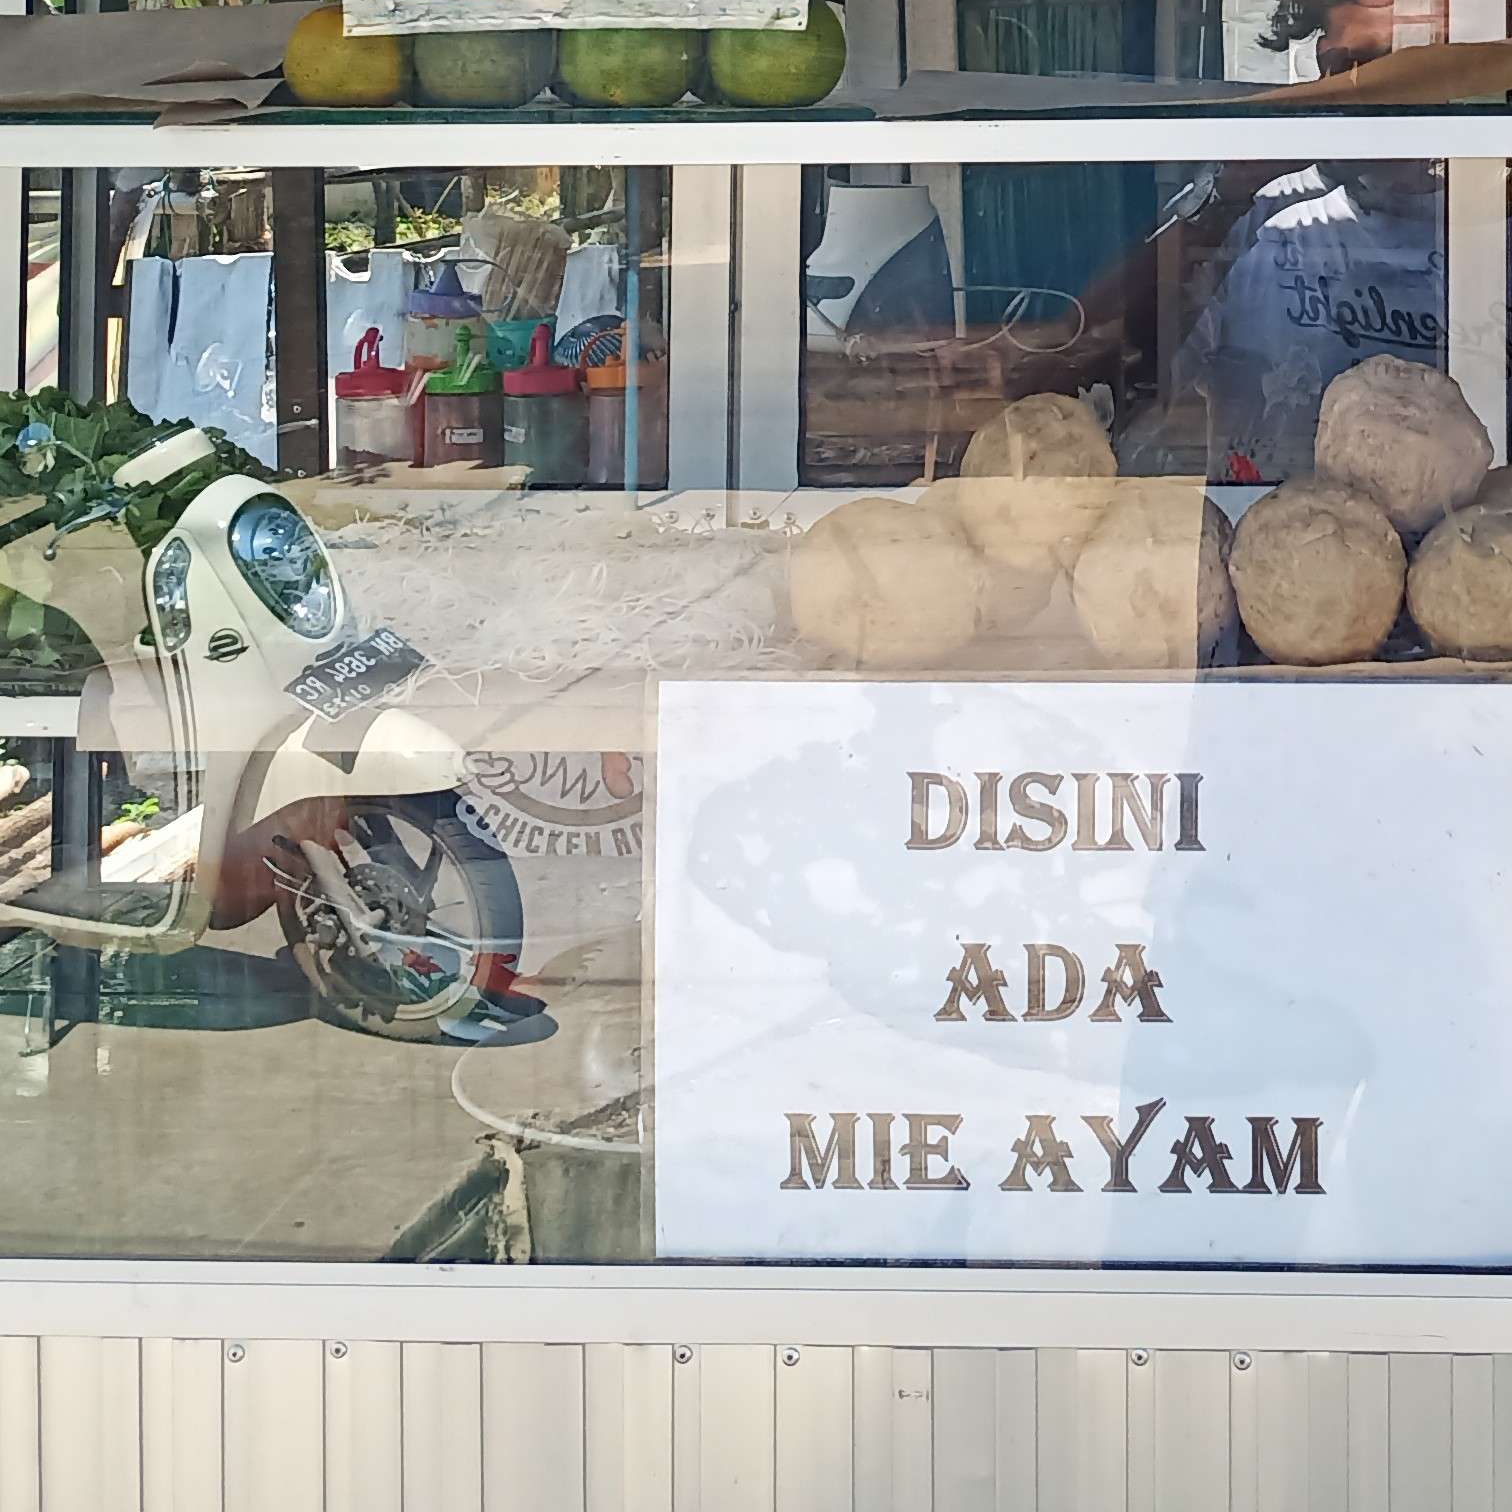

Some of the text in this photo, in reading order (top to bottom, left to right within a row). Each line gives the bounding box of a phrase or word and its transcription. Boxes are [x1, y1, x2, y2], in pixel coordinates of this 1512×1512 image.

[904, 770, 1207, 852] DISINI
[932, 942, 1174, 1024] ADA
[779, 1096, 1328, 1196] MIE AYAM
